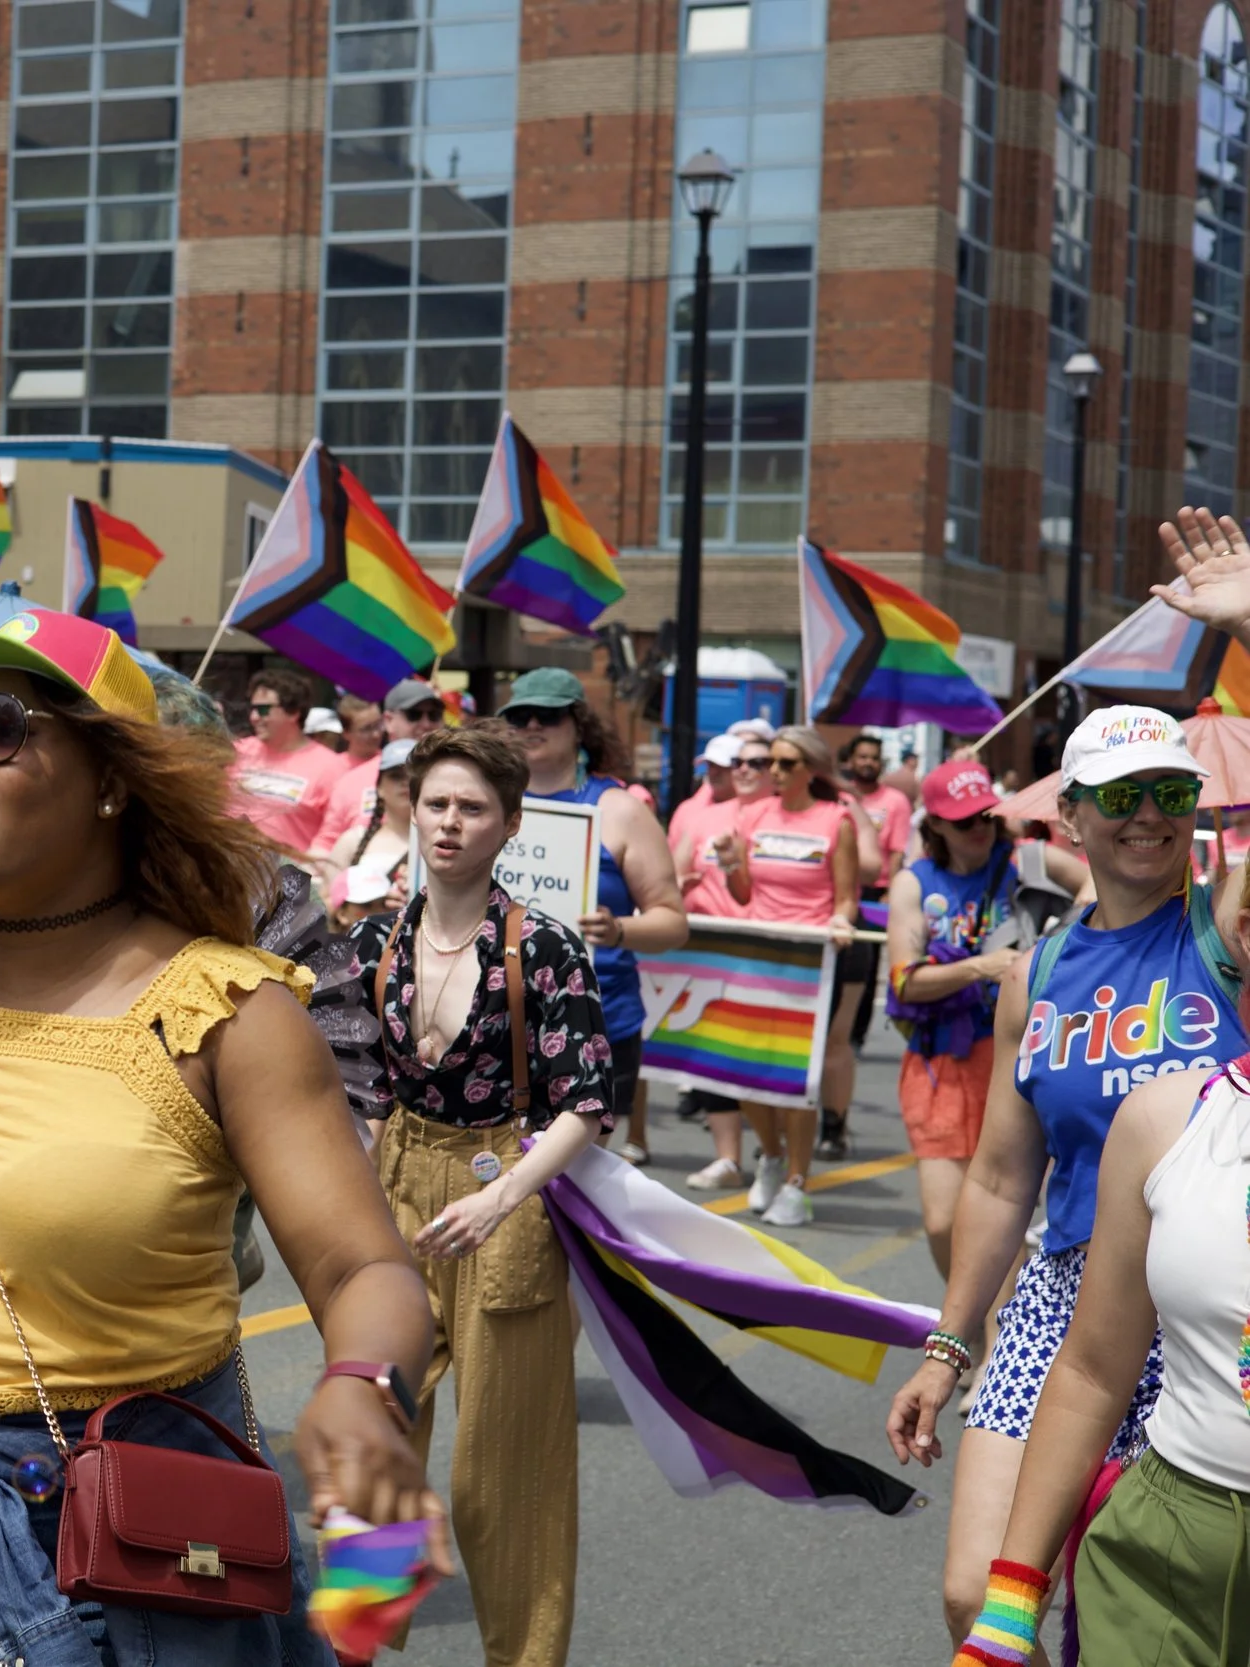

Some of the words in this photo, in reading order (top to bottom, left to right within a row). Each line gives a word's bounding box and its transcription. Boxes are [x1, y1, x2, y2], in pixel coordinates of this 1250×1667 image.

[532, 845, 546, 859] a
[494, 864, 524, 885] for
[531, 874, 569, 892] you
[1018, 977, 1219, 1082] Pride
